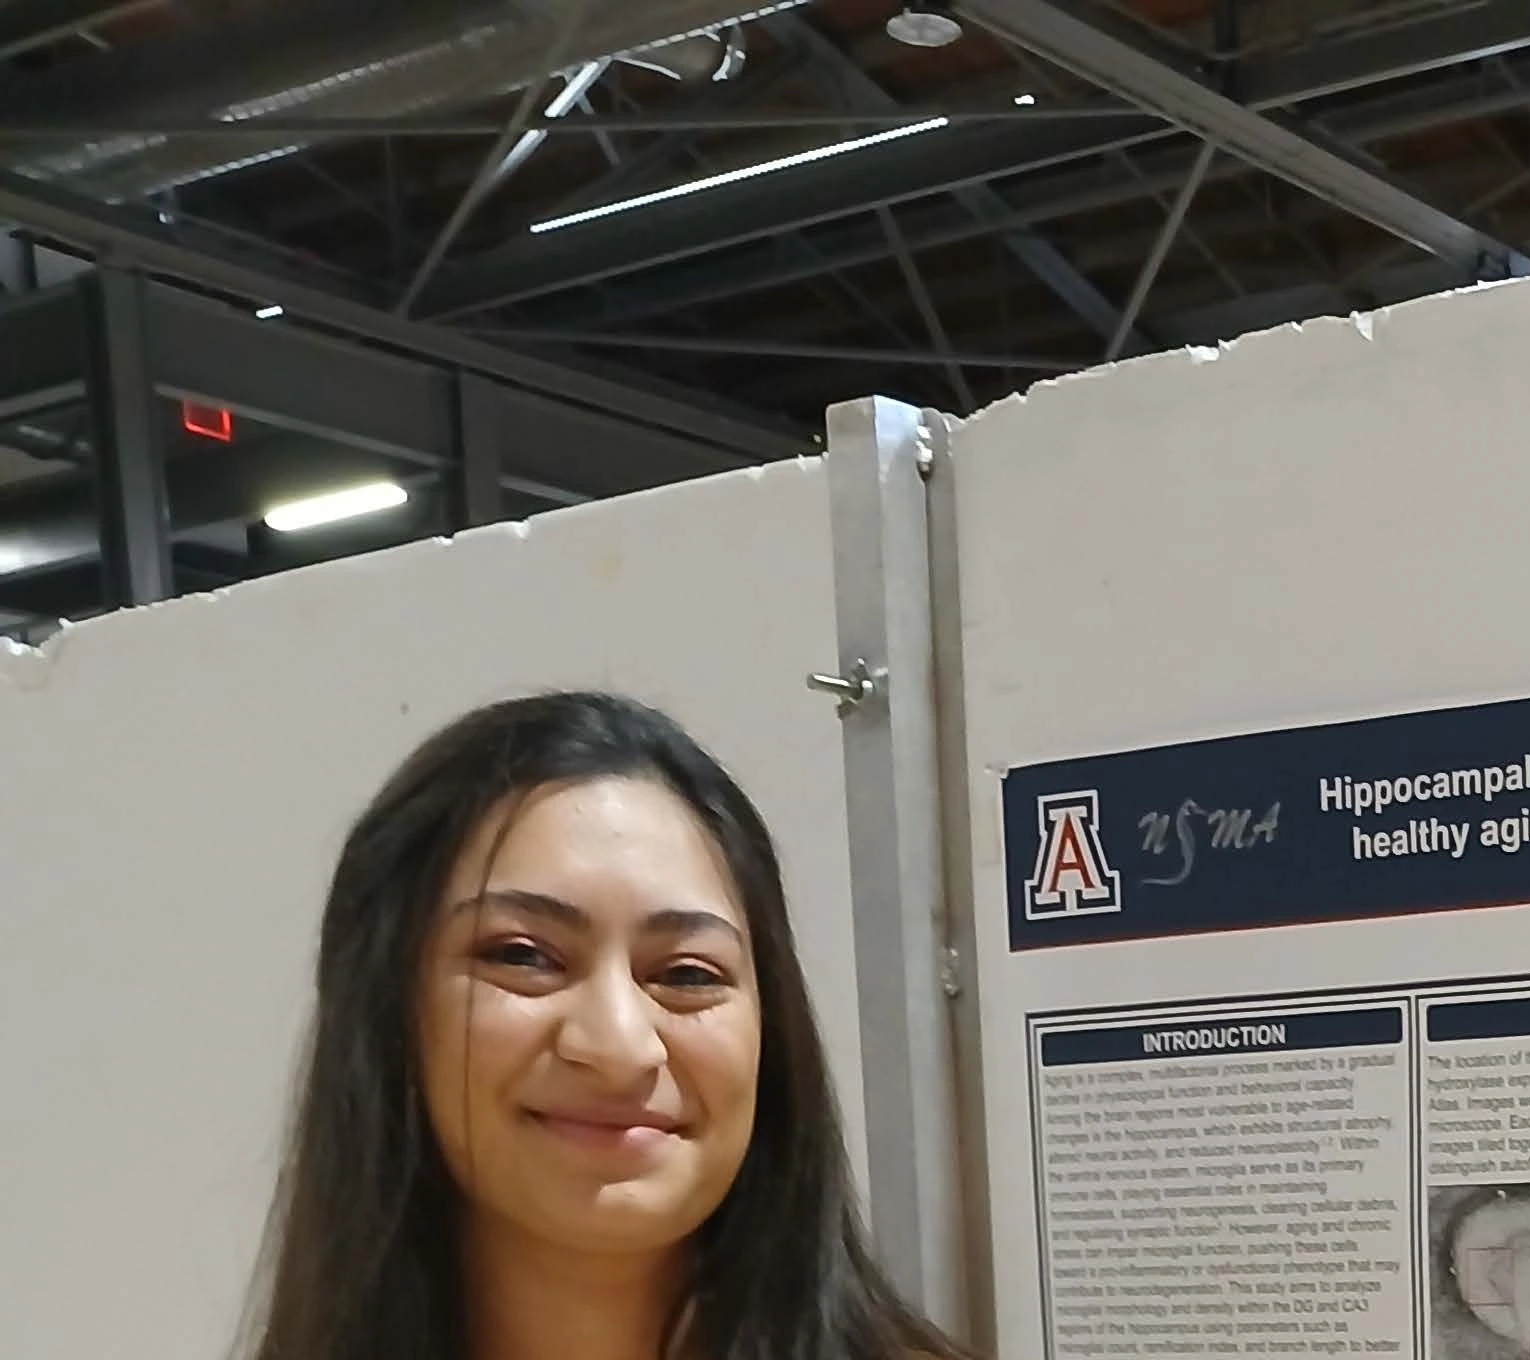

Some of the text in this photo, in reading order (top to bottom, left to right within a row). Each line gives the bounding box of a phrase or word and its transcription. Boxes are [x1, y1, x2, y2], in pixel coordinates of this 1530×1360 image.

[1024, 789, 1122, 920] A
[1353, 816, 1469, 859] healthy
[1143, 1024, 1286, 1053] INTRODUCTION
